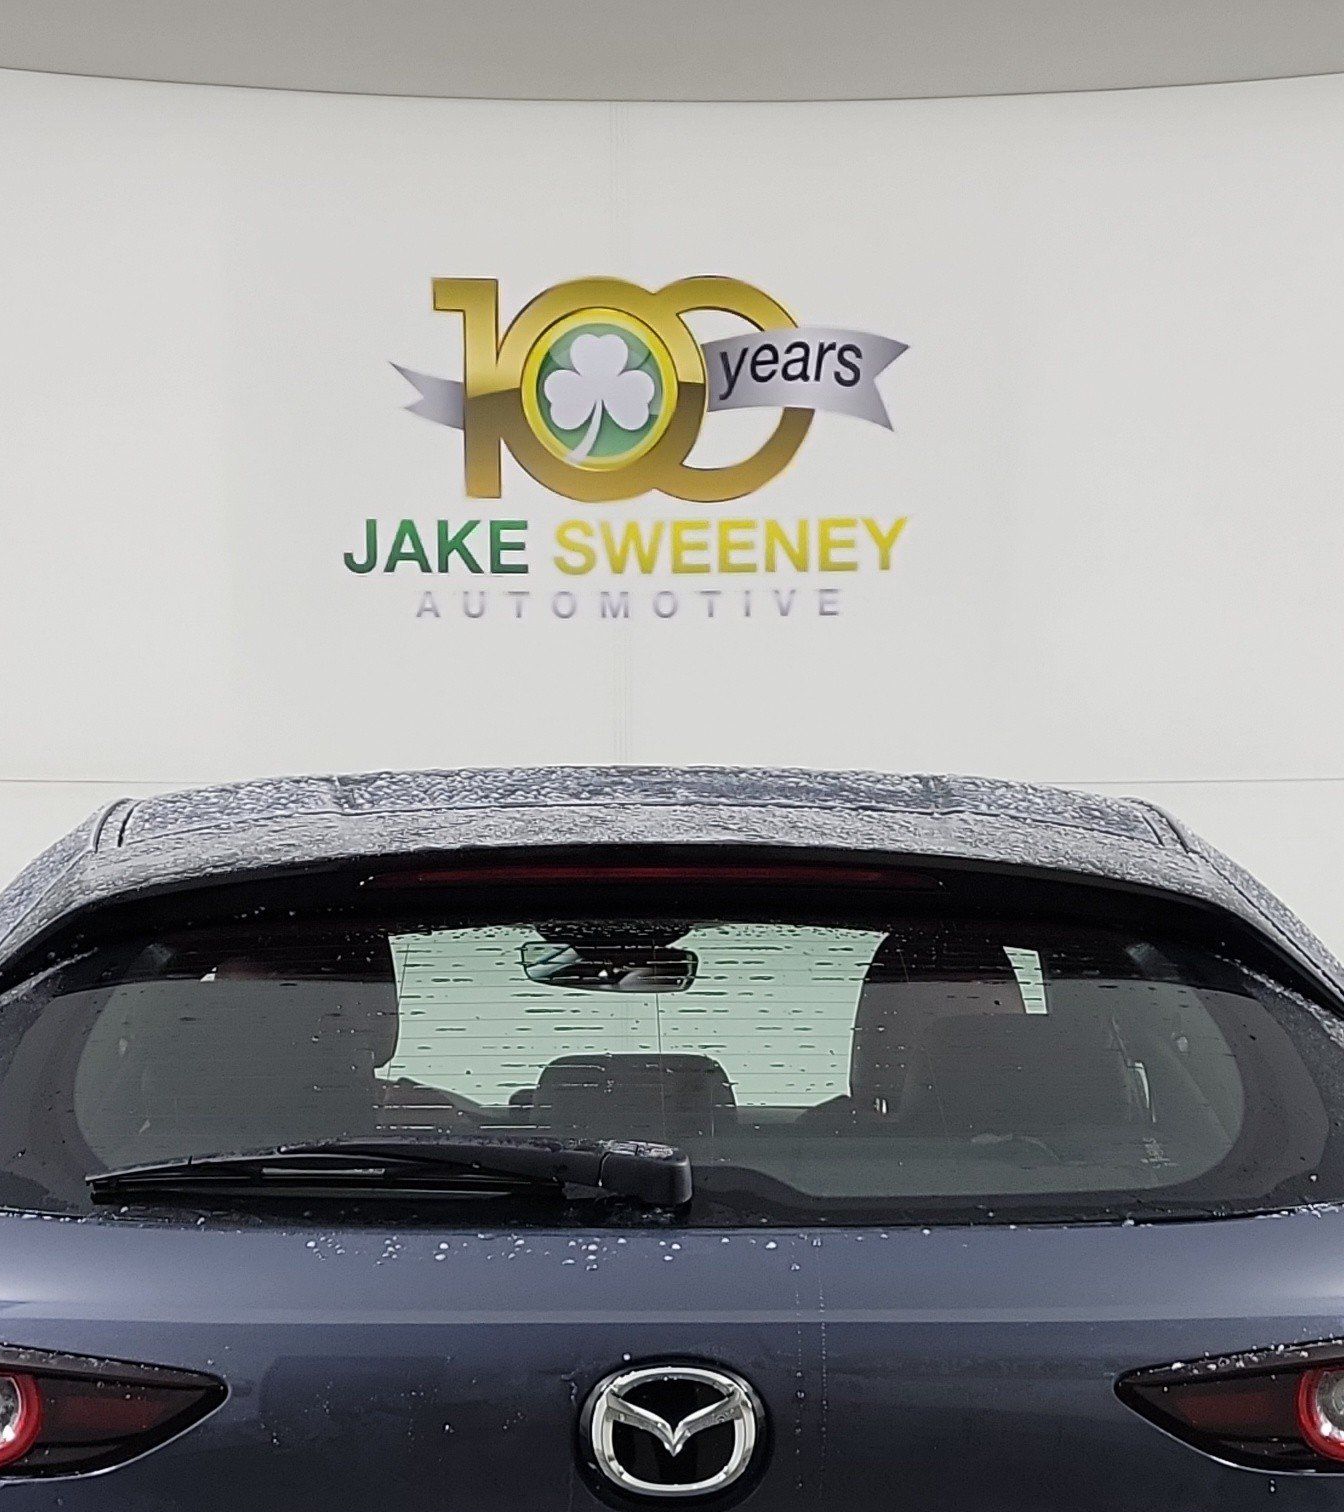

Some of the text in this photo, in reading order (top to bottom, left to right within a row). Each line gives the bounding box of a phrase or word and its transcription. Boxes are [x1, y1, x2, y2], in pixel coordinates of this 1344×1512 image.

[717, 338, 863, 399] years
[343, 516, 908, 575] JAKE SWEENEY
[416, 588, 842, 619] AUTOMOTIVE
